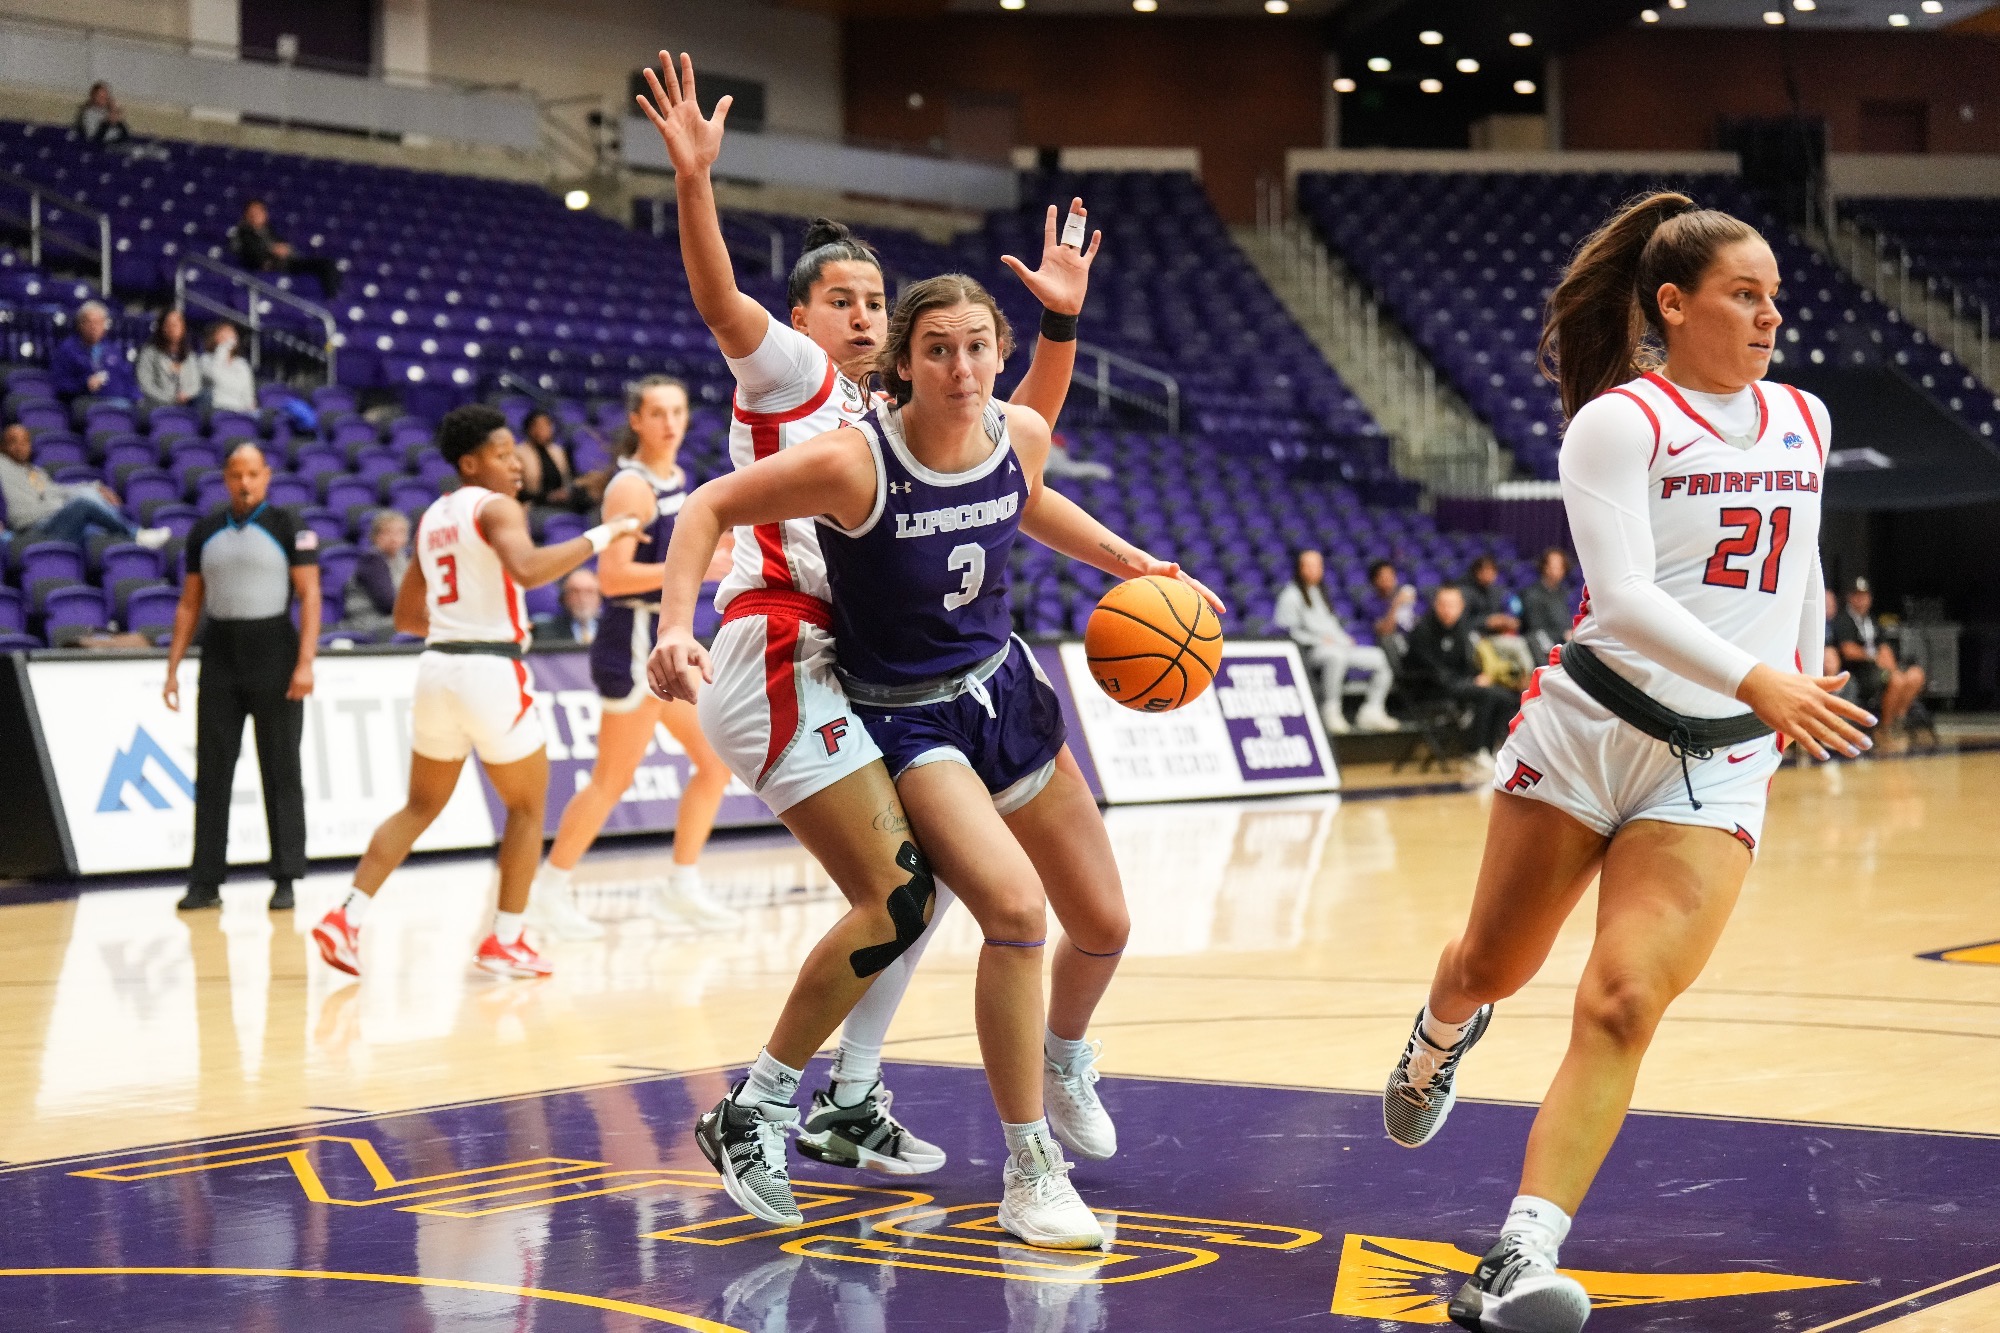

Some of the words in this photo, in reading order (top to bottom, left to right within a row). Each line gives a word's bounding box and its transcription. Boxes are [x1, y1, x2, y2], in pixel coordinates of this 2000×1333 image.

[1661, 471, 1818, 499] FAIRFIELD
[896, 491, 1019, 539] LIPSCOMB
[1702, 506, 1792, 594] 21
[436, 554, 459, 605] 3
[943, 542, 986, 612] 3
[813, 716, 850, 758] F
[1504, 758, 1544, 793] F
